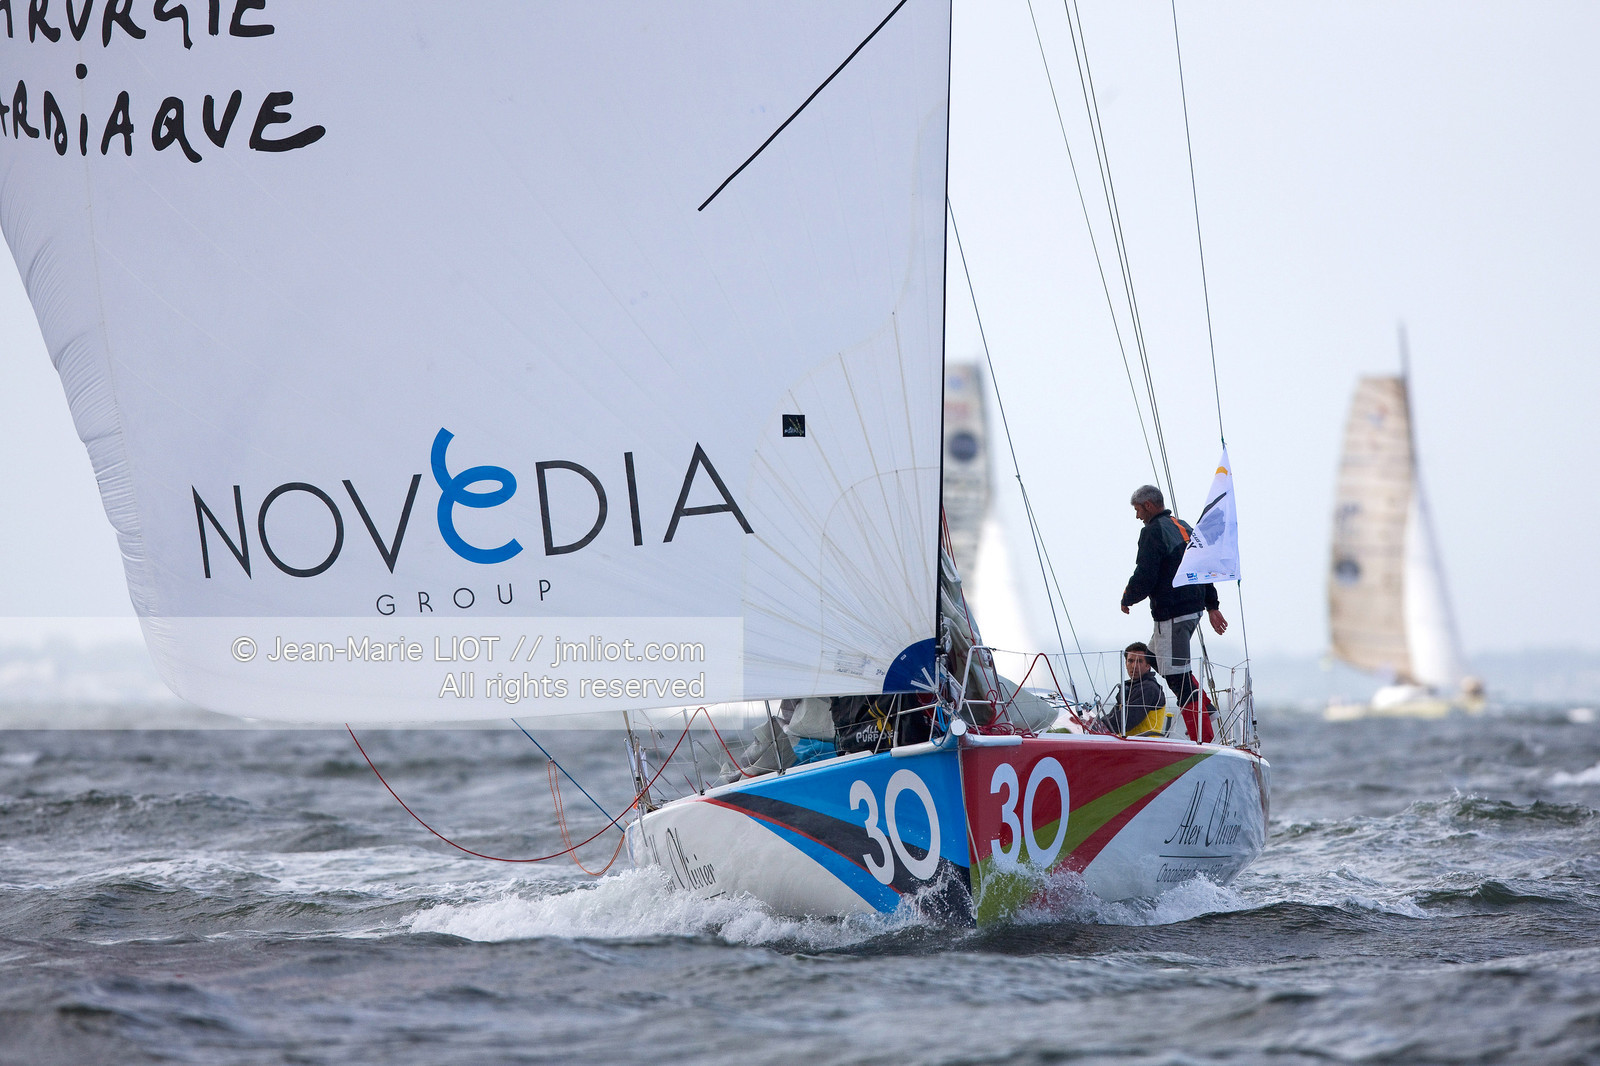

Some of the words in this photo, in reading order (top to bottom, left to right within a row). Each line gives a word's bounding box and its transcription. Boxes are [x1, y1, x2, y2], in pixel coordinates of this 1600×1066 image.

[376, 579, 552, 616] GROUP
[849, 768, 941, 886] 30
[990, 756, 1070, 870] 30
